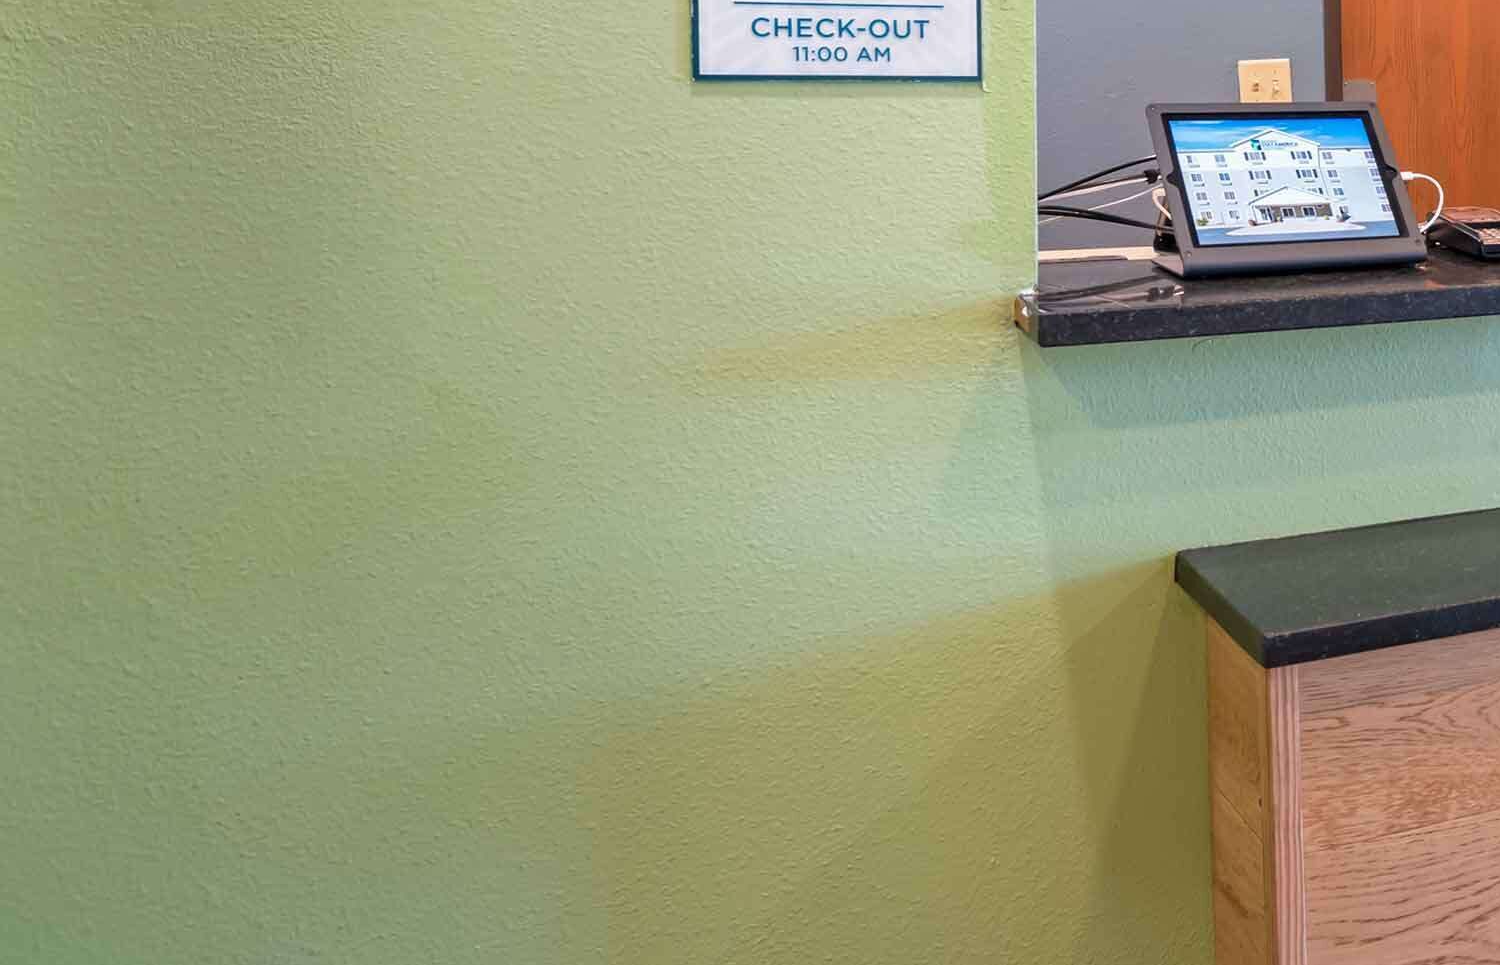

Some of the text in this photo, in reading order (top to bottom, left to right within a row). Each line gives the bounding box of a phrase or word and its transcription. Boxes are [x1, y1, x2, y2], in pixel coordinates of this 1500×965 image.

[750, 16, 930, 39] CHECK-OUT
[792, 46, 891, 62] 11:00 AM
